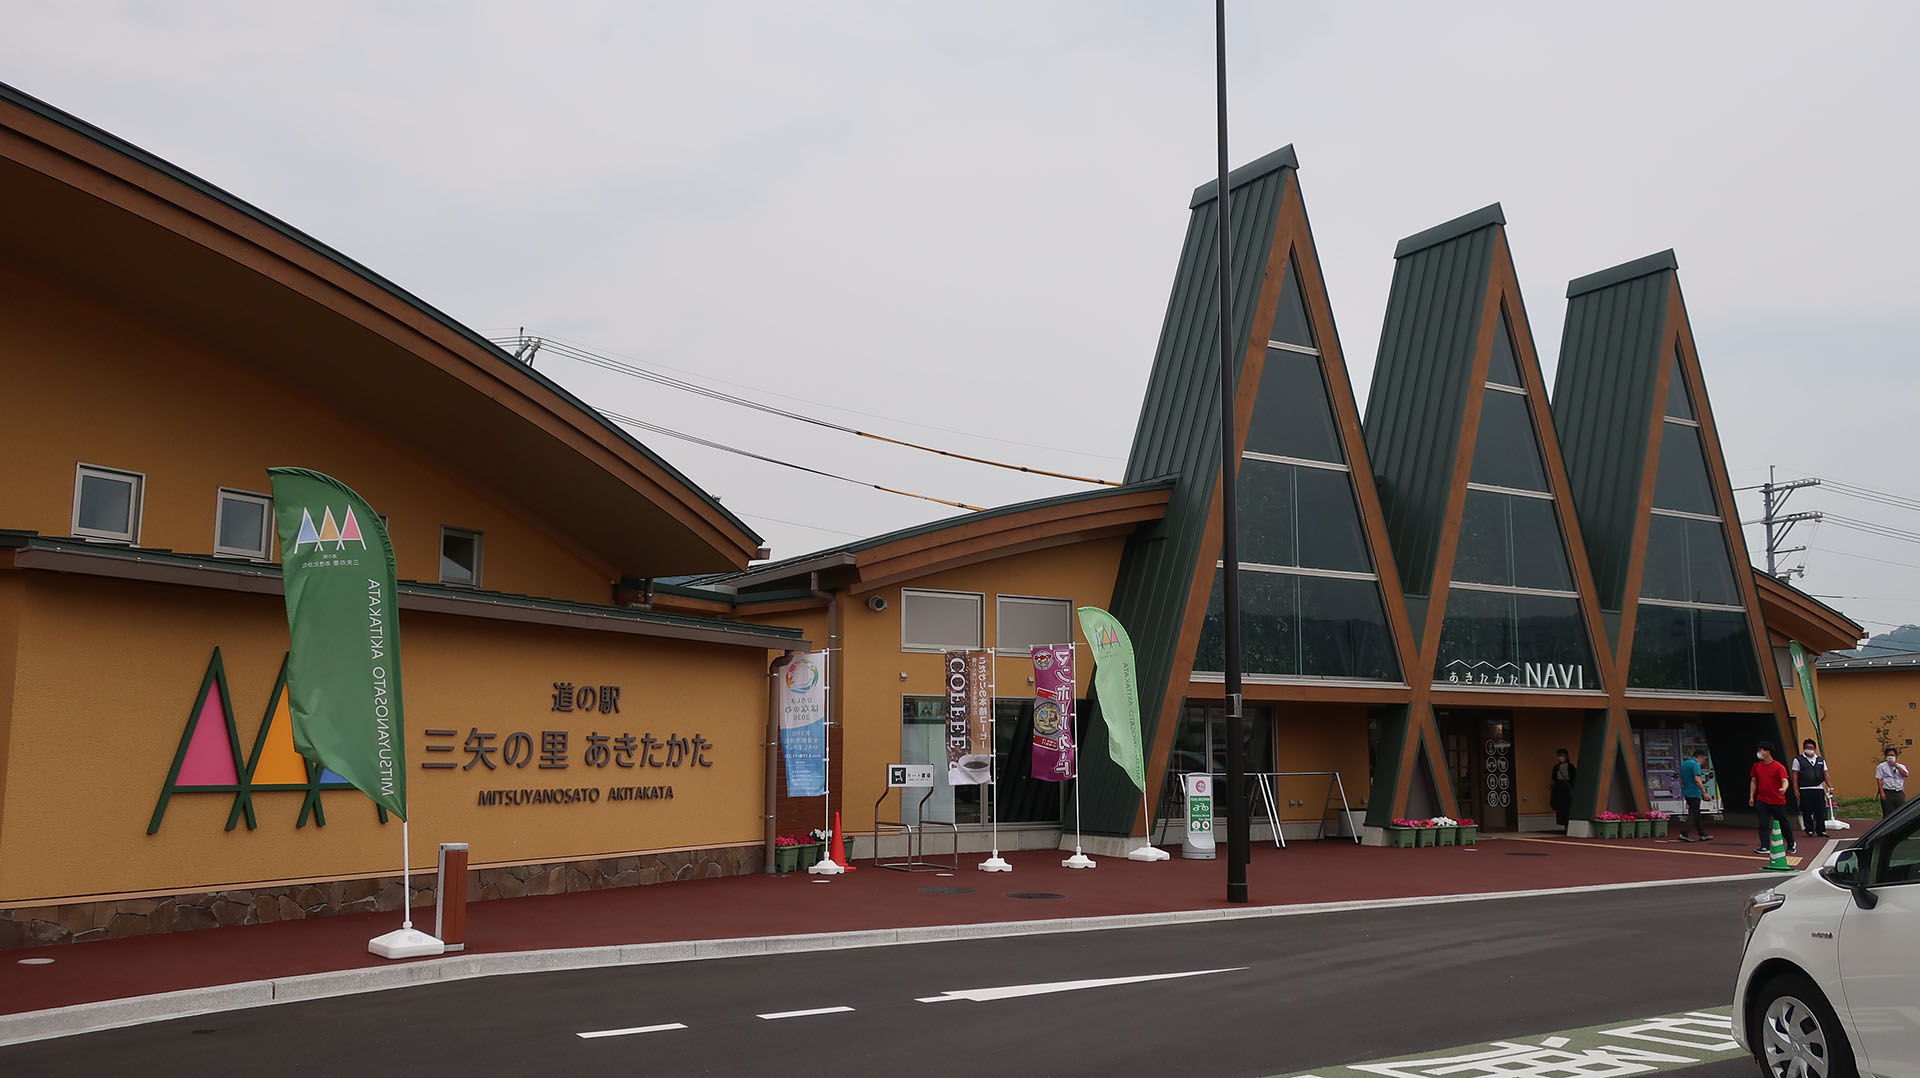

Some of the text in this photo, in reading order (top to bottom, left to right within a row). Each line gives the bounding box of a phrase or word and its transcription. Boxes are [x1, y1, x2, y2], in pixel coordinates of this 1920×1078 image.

[1449, 662, 1583, 689] あきたかた NAVI
[552, 682, 621, 714] 道の駅
[421, 727, 713, 771] 三矢の里 あきたかた
[478, 785, 674, 807] MITSUYANOSATO AKITAKATA
